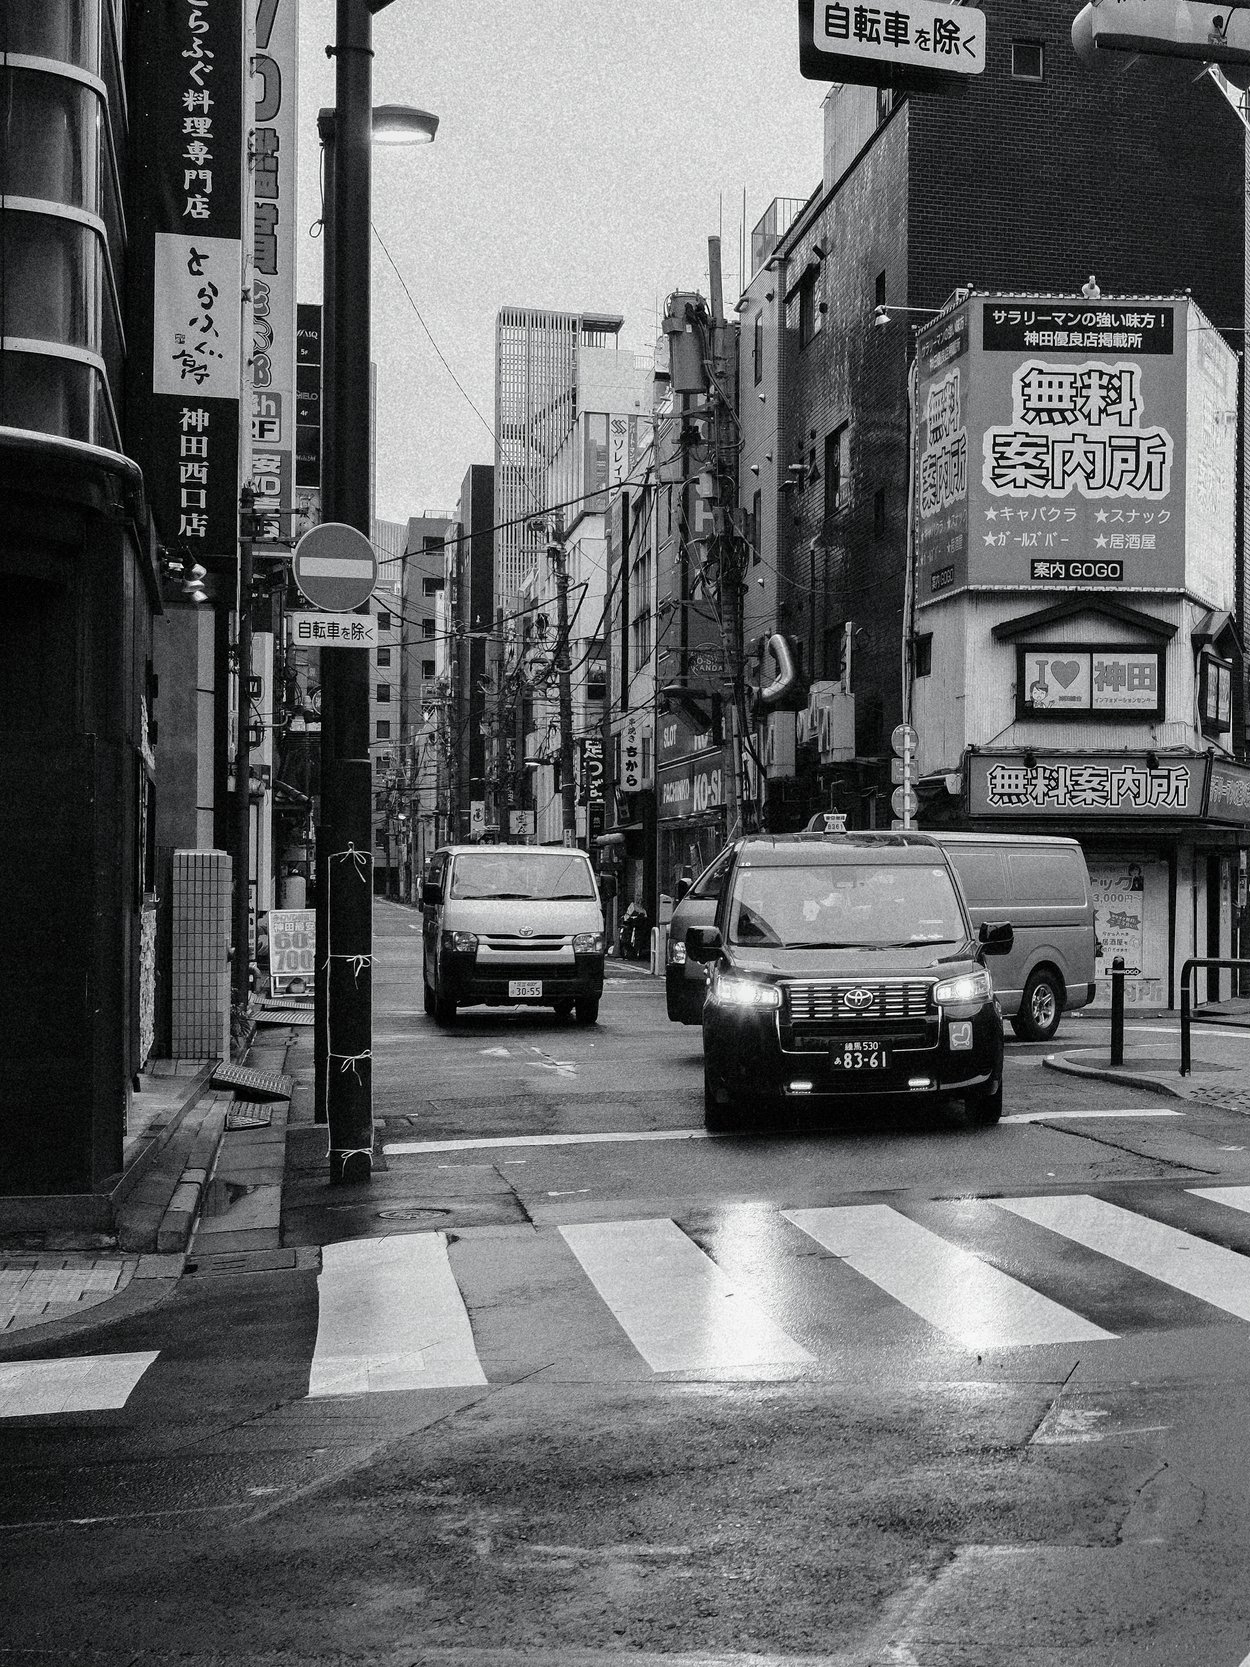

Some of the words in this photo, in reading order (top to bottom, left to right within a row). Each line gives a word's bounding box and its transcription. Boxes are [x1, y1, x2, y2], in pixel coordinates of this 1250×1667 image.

[824, 2, 977, 59] 自転車を除く
[181, 0, 215, 219] らふぐ料理専門店
[992, 310, 1166, 328] サラリーマンの強い味方！
[1023, 330, 1142, 348] 神田優良店掲載所
[1019, 367, 1138, 427] 無料
[178, 407, 210, 538] 神田西口店
[990, 431, 1167, 494] 案内所
[999, 507, 1077, 523] キャバクラ
[1110, 508, 1171, 524] スナック
[1109, 533, 1156, 549] 居酒屋
[1033, 562, 1066, 577] 案内
[1069, 563, 1121, 579] GOGO
[298, 620, 374, 640] 自転車を除く
[1093, 661, 1157, 692] 神田
[663, 724, 677, 749] SLOT
[663, 777, 690, 804] PACHINKO
[987, 764, 1191, 808] 無料案内所
[516, 987, 541, 996] 30-55
[844, 1042, 862, 1051] 練馬
[862, 1041, 879, 1050] 530
[834, 1056, 842, 1065] あ
[843, 1051, 887, 1069] 83-61
